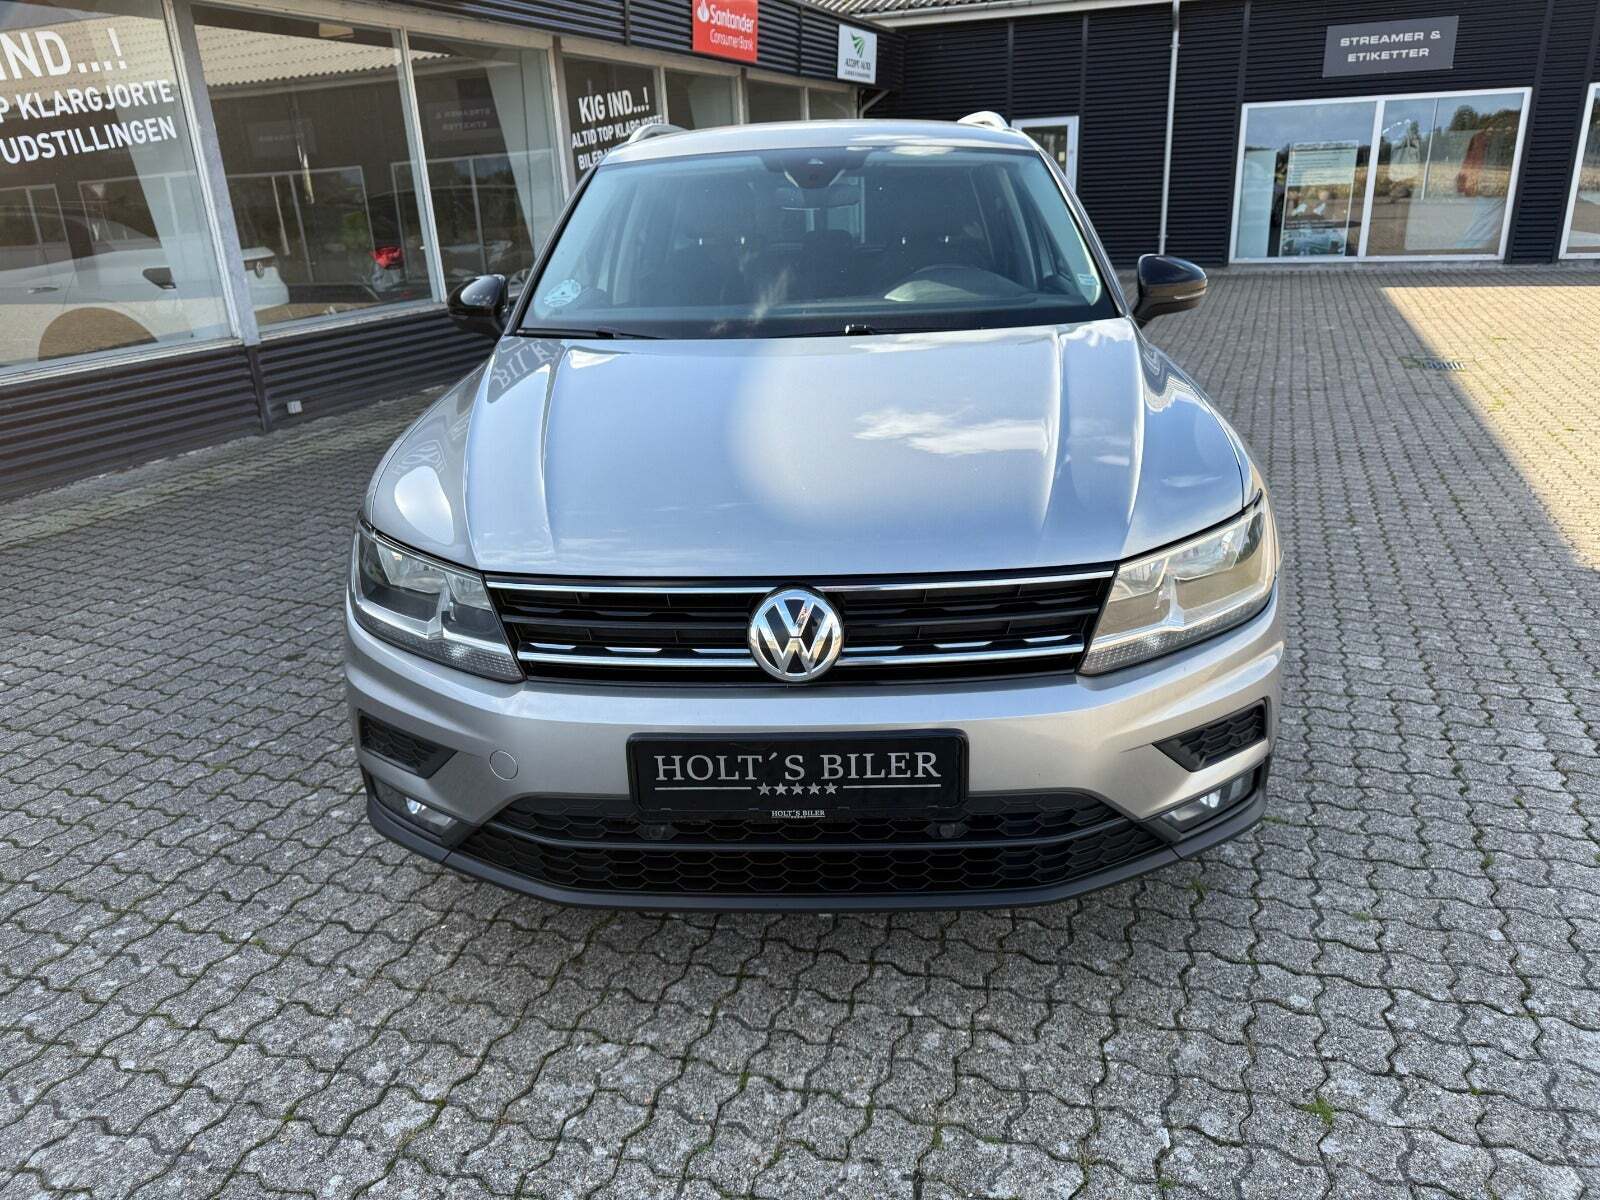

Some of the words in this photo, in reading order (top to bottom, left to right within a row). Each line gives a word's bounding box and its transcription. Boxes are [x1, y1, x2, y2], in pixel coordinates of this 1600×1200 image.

[710, 4, 754, 33] Santander
[1340, 32, 1424, 47] STREAMER
[1430, 30, 1441, 40] &
[1347, 48, 1430, 63] ETIKETTER
[18, 79, 175, 120] KLARGJORTE
[578, 94, 606, 124] KIG
[608, 86, 650, 118] IND...!
[0, 115, 177, 165] UDSTILLINGEN
[571, 129, 597, 149] ALTID
[597, 125, 614, 143] TOP
[752, 592, 839, 678] VW
[820, 751, 941, 780] BILER
[802, 809, 825, 817] BILER
